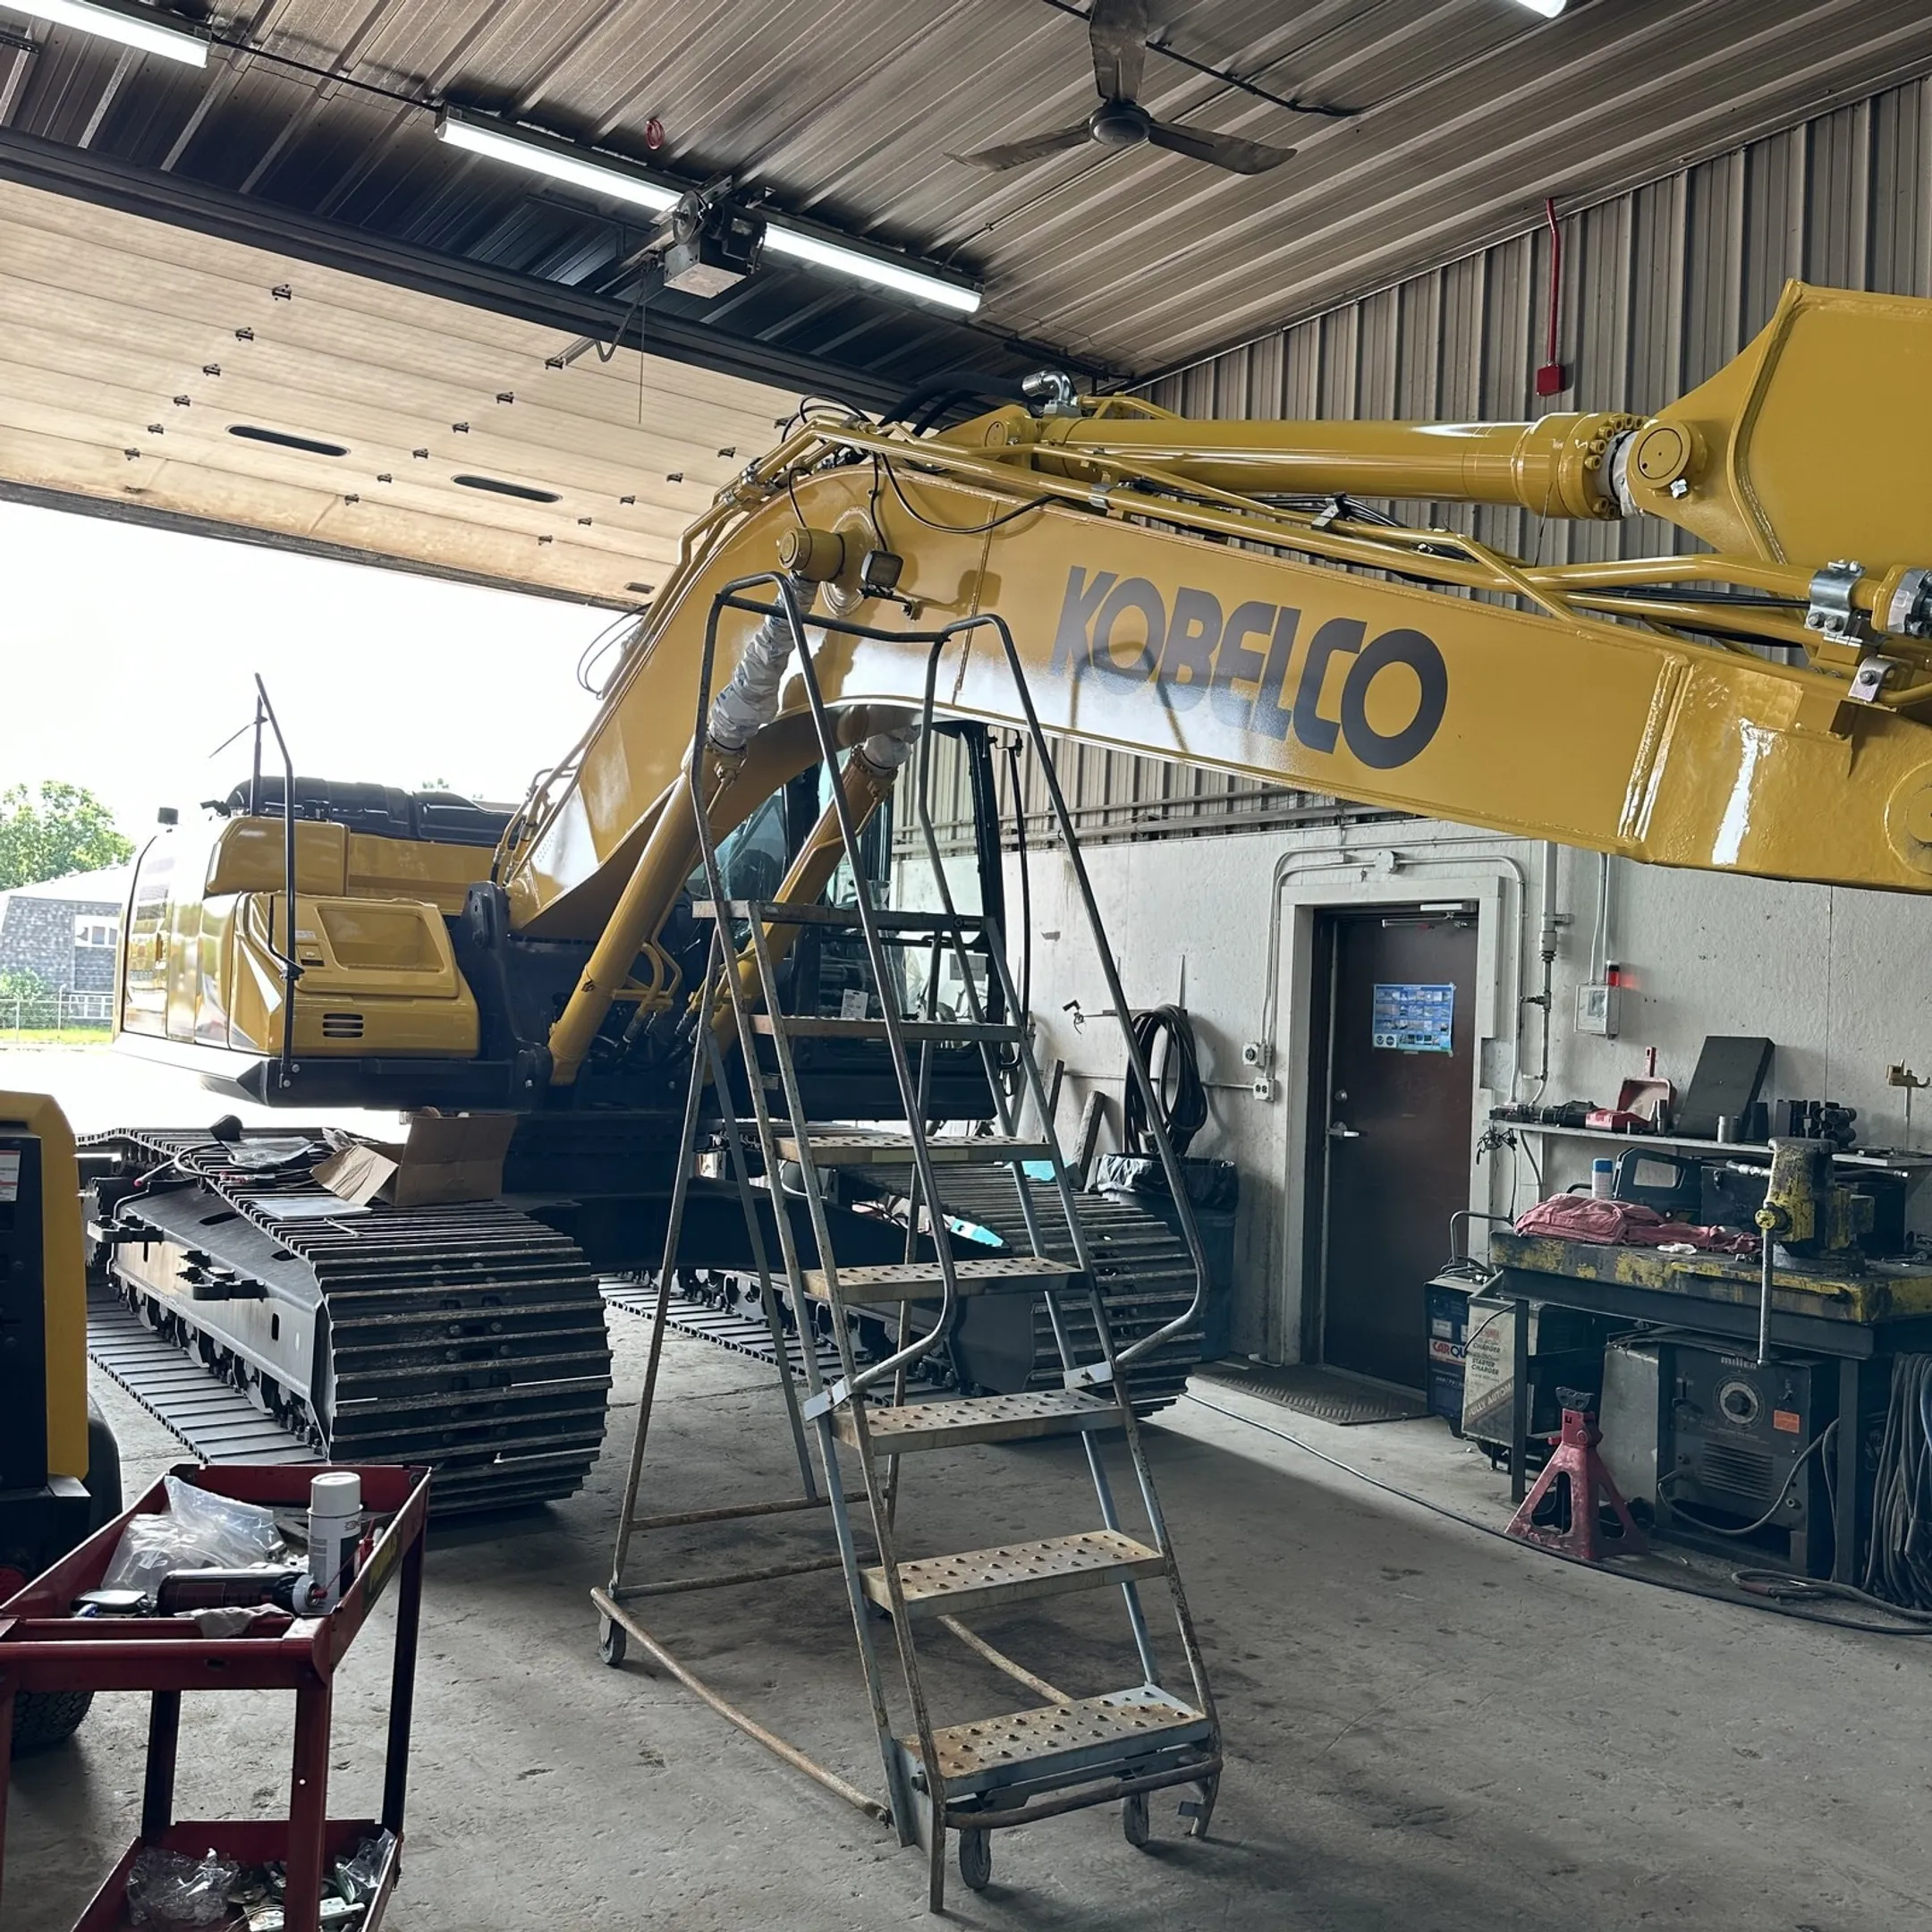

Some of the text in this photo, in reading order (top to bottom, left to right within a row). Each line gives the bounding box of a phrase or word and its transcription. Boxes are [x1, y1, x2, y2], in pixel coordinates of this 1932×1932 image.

[1050, 565, 1448, 769] KOBELCO
[1472, 1343, 1501, 1353] CHARGER
[1471, 1358, 1496, 1367] STARTER
[1471, 1365, 1500, 1375] CHARGER
